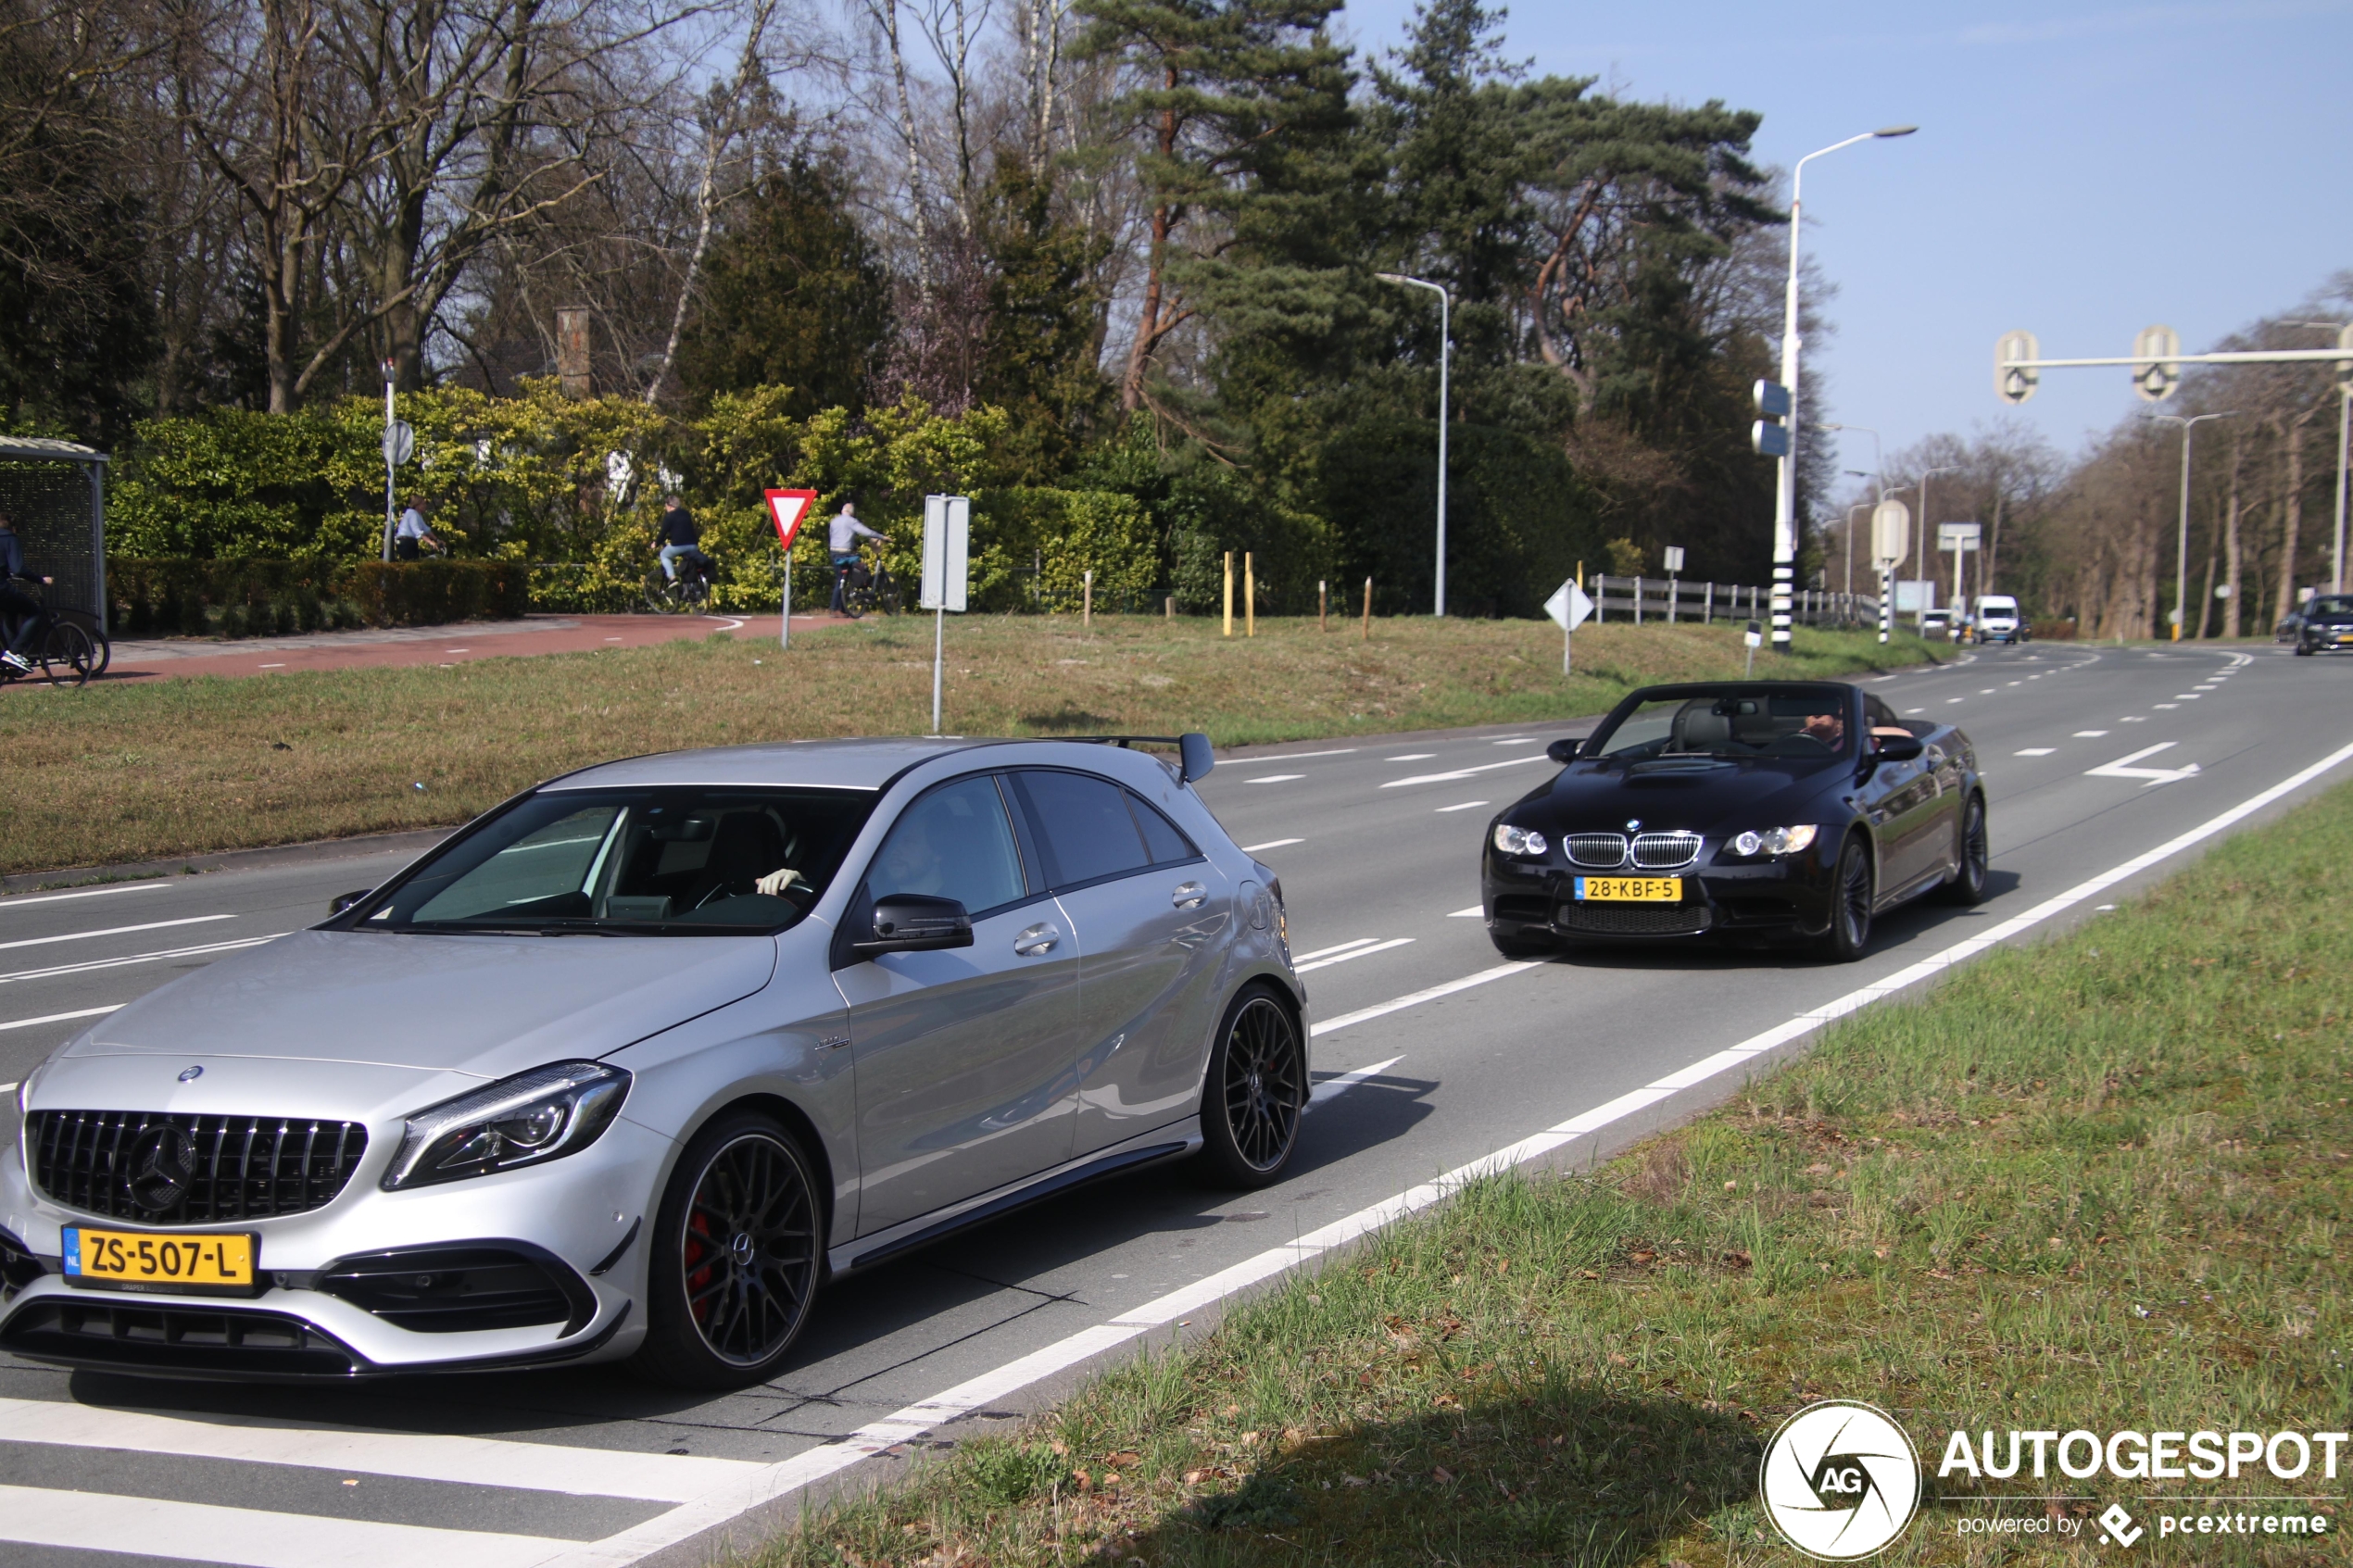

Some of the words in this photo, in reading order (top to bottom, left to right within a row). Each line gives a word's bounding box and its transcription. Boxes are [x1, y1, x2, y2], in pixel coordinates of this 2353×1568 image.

[1590, 881, 1673, 897] 28-KBF-5
[68, 1255, 80, 1267] NL
[90, 1236, 236, 1277] ZS-507-L
